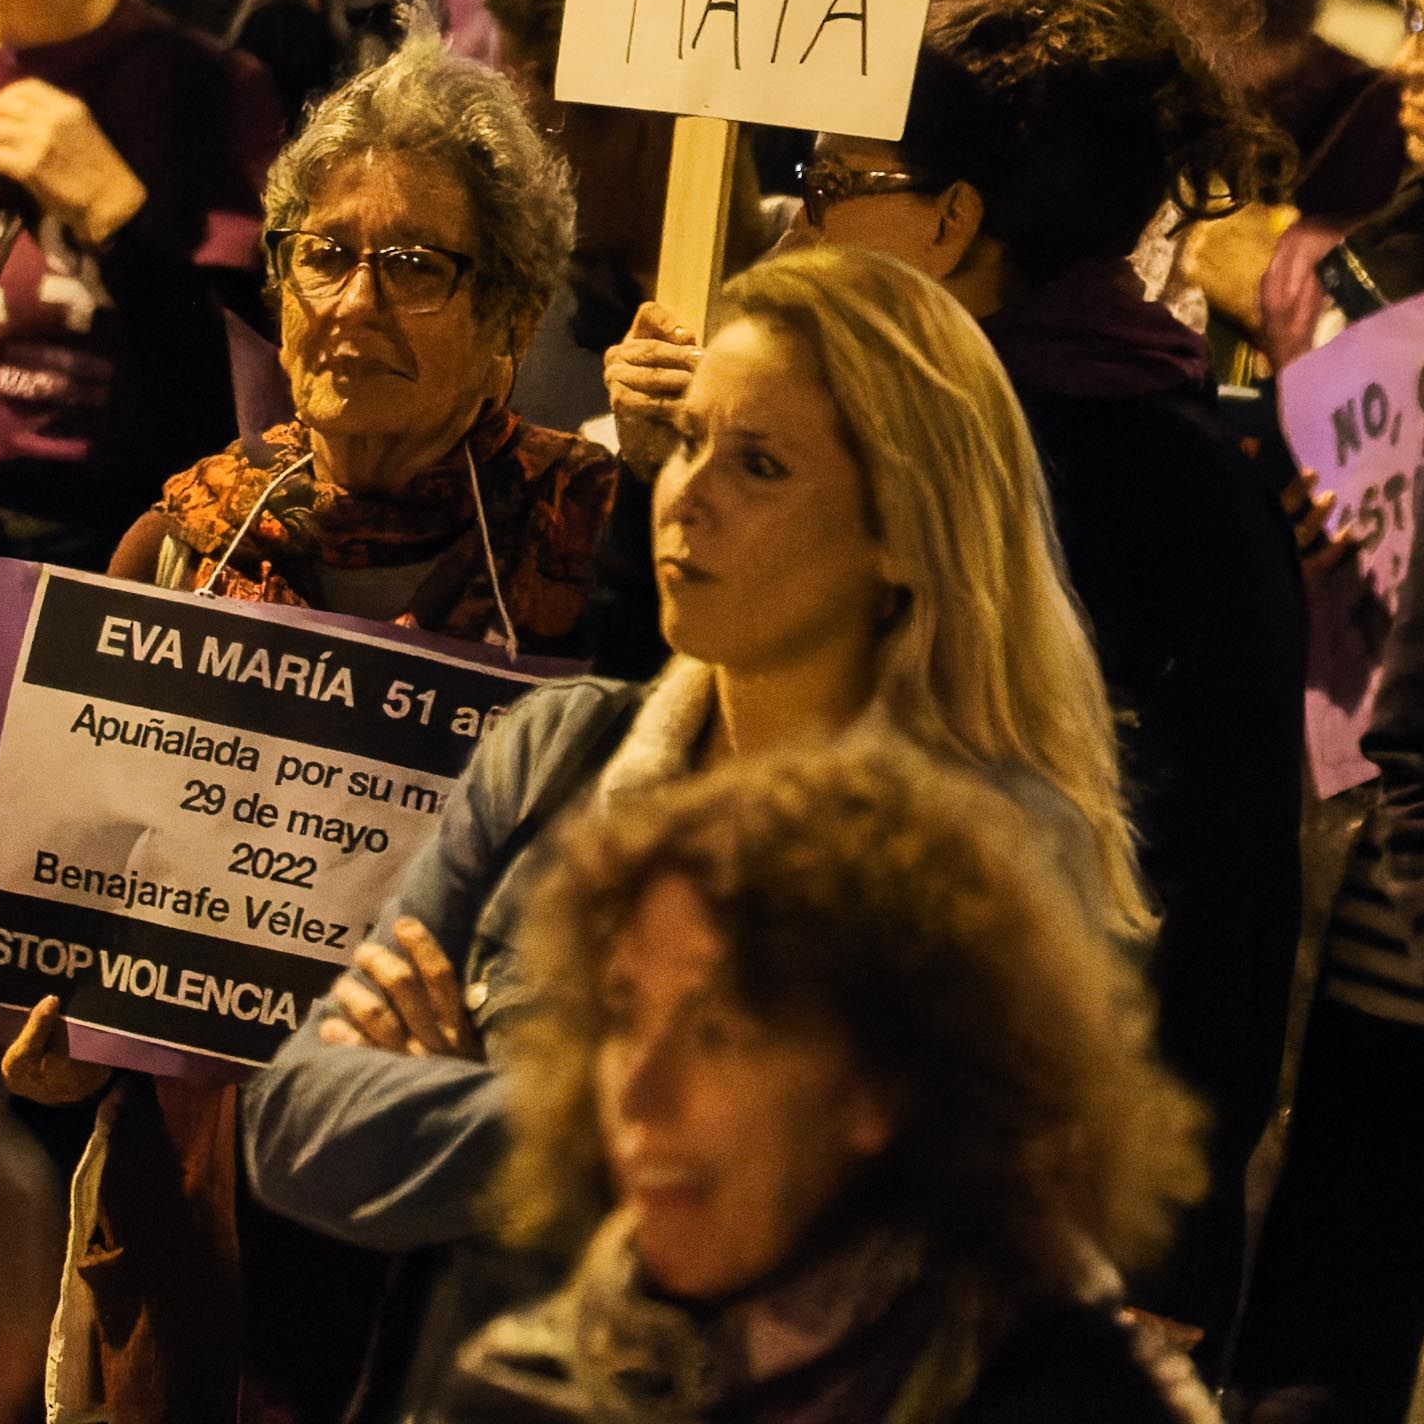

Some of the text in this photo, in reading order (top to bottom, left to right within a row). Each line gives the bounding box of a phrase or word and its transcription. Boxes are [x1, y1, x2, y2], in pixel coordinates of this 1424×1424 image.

[95, 614, 184, 670] EVA
[196, 635, 356, 709] MARÍA
[382, 679, 437, 726] 51
[70, 703, 261, 773] Apuñalada
[274, 754, 343, 788] por
[346, 770, 394, 803] su
[179, 778, 390, 855] 29 de mayo
[32, 849, 351, 951] Benajarafe Vélez
[227, 841, 318, 890] 2022
[98, 949, 298, 1031] VIOLENCIA
